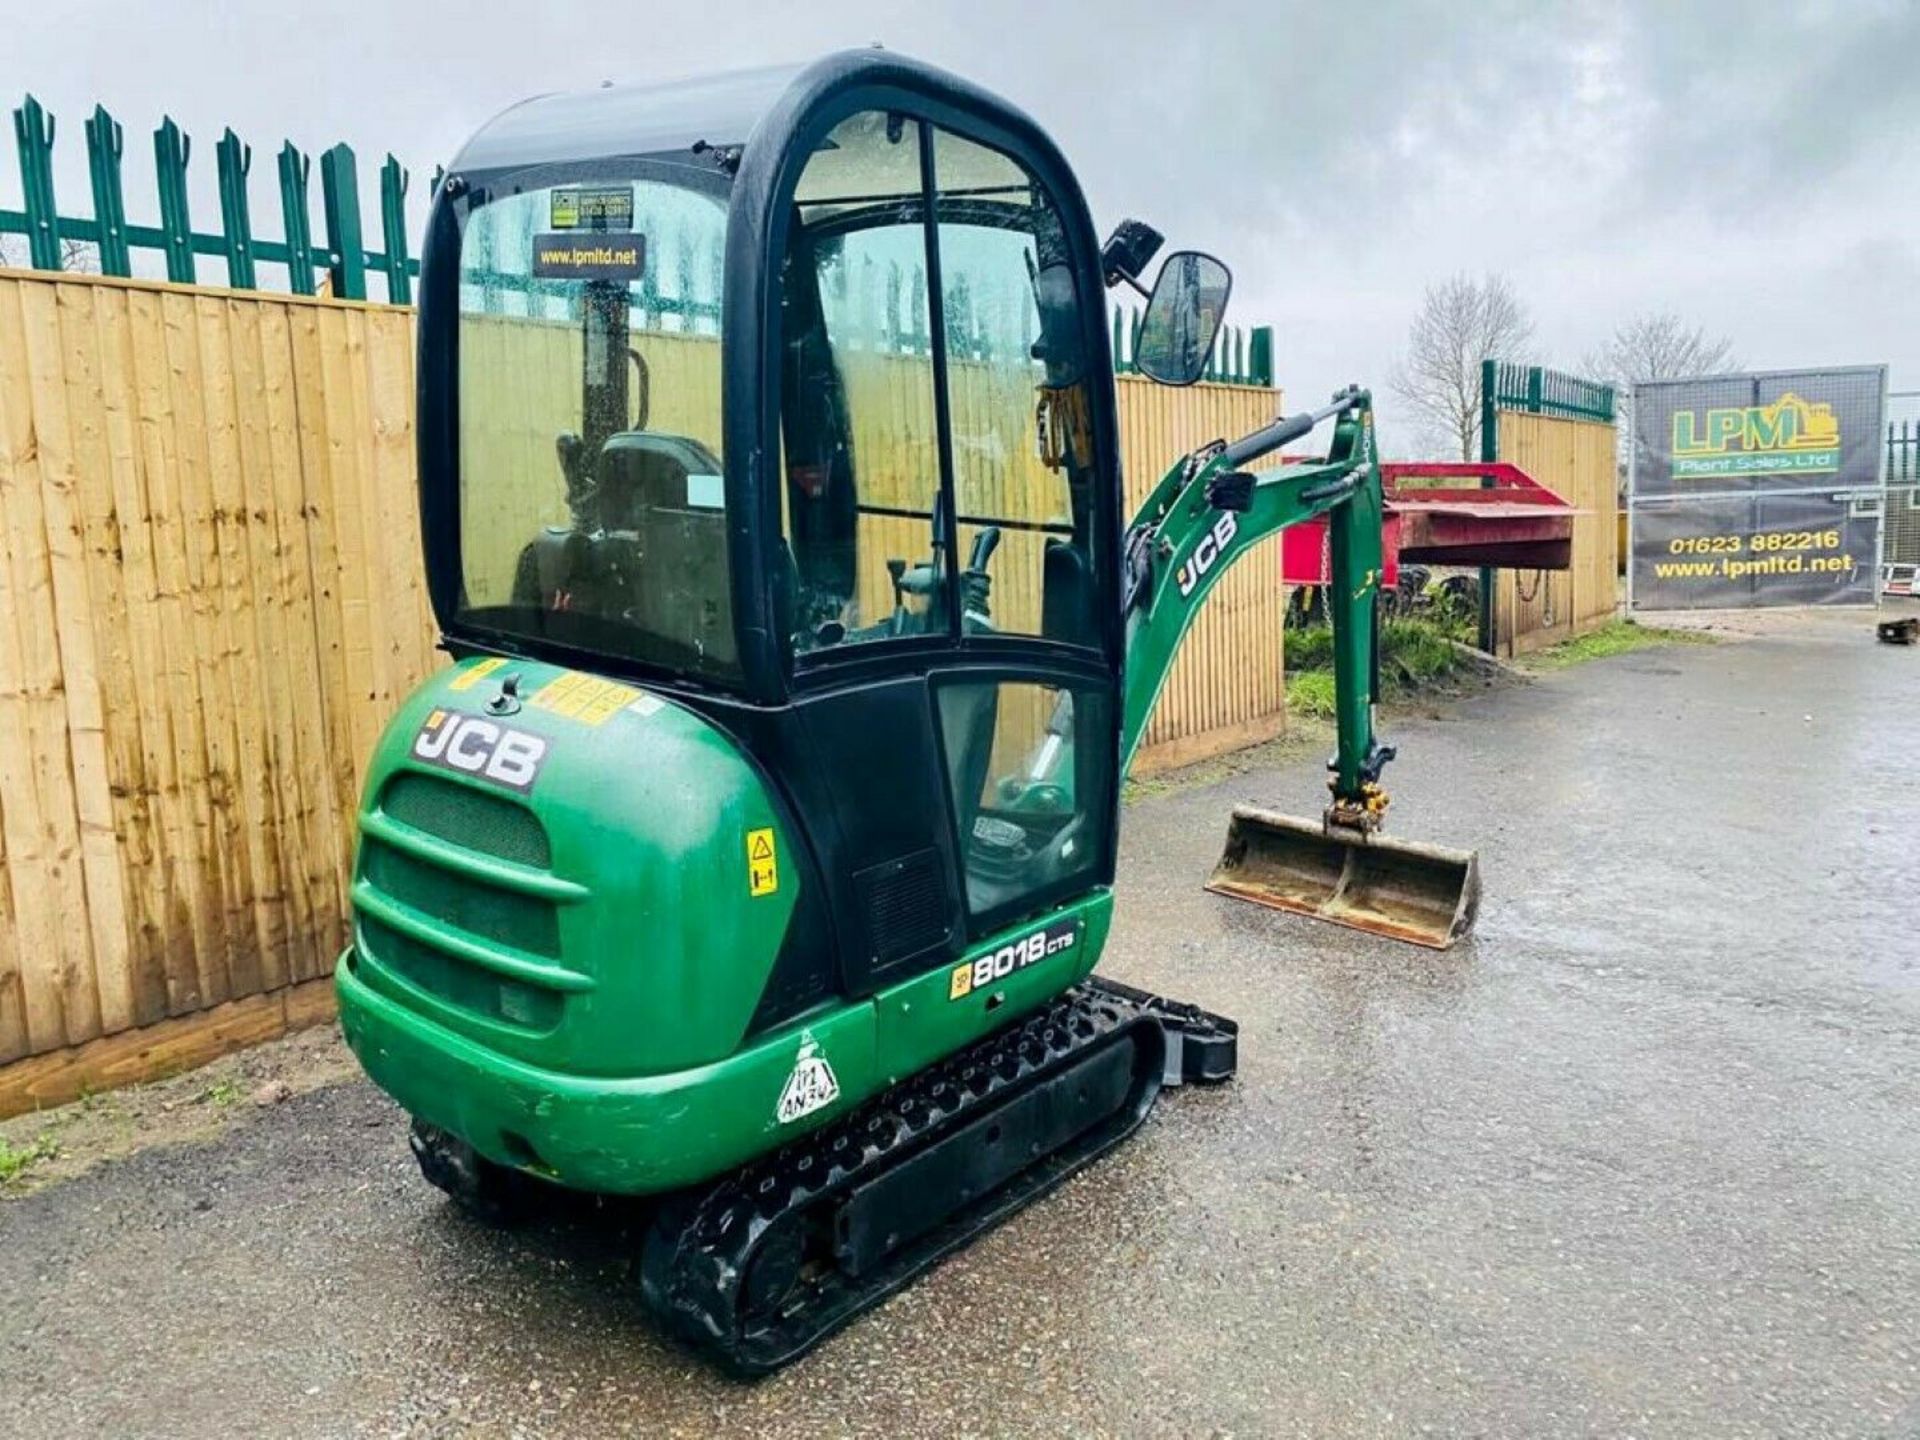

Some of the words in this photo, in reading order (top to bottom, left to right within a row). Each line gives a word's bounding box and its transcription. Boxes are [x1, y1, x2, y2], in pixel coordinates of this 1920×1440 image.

[540, 247, 638, 267] www.lpmltd.net
[1673, 406, 1798, 454] LPM
[1795, 452, 1831, 467] Ltd
[1177, 511, 1238, 596] JCB
[1669, 535, 1741, 556] 01623
[1749, 530, 1840, 551] 882216
[1655, 554, 1852, 579] www.lpmltd.net
[414, 711, 546, 787] JCB
[972, 931, 1046, 988] 8018
